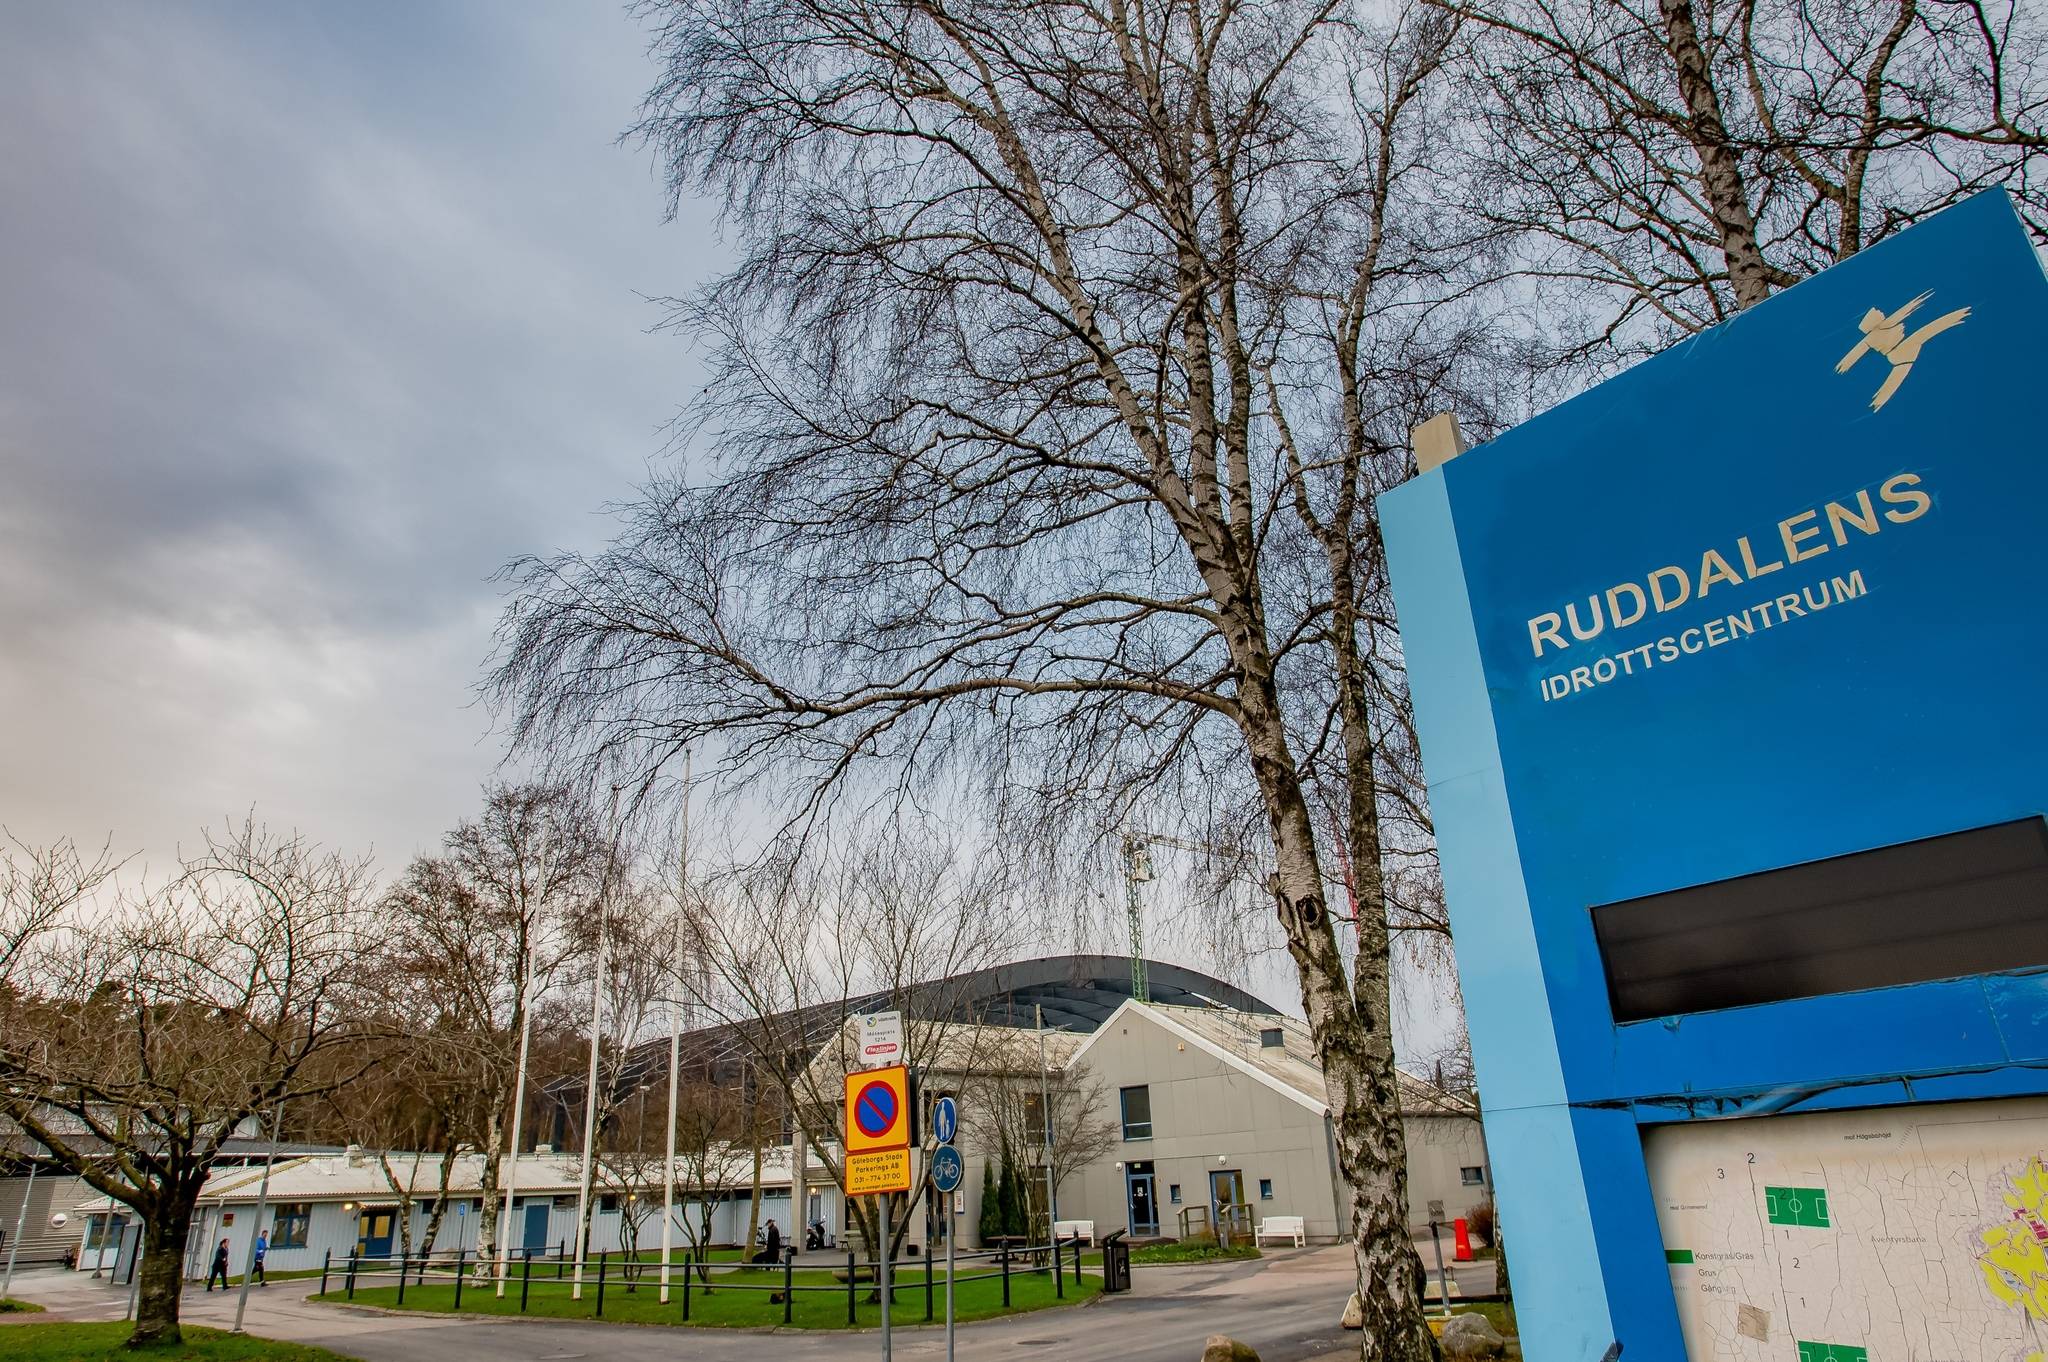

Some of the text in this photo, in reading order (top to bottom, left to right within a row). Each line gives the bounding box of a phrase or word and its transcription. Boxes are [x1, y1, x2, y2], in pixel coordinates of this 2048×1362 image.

[1527, 473, 1931, 658] RUDDALENS
[1541, 569, 1868, 702] IDROTTSCENTRUM
[851, 1156, 884, 1165] Göteborgs
[1747, 1152, 1755, 1164] 2
[855, 1165, 889, 1173] Parkerings
[1717, 1168, 1725, 1179] 3
[883, 1173, 890, 1181] 37
[1779, 1188, 1787, 1200] 2
[1785, 1229, 1790, 1240] 1
[1792, 1258, 1800, 1269] 2
[1698, 1268, 1717, 1277] Grus
[1800, 1297, 1806, 1308] 1
